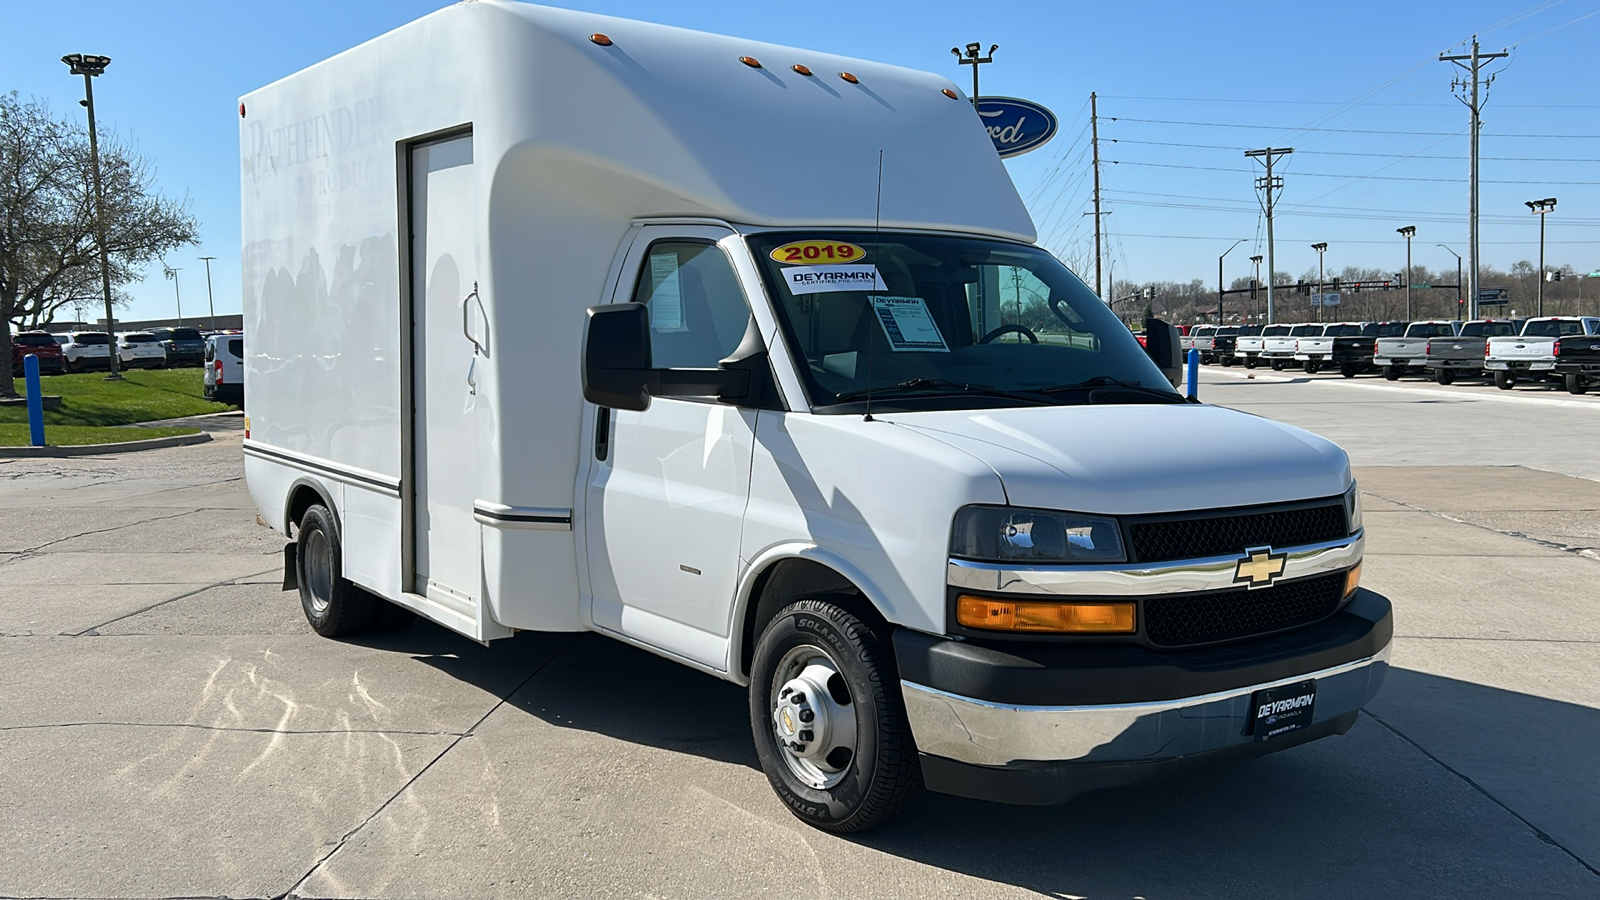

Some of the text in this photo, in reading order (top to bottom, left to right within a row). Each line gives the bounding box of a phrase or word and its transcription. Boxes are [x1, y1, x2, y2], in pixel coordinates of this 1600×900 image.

[784, 245, 855, 261] 2019
[793, 271, 875, 282] DEYARMAN
[876, 297, 919, 305] DEYARMAN
[798, 618, 849, 662] SOLARUS
[1257, 693, 1314, 719] DEYARMAN
